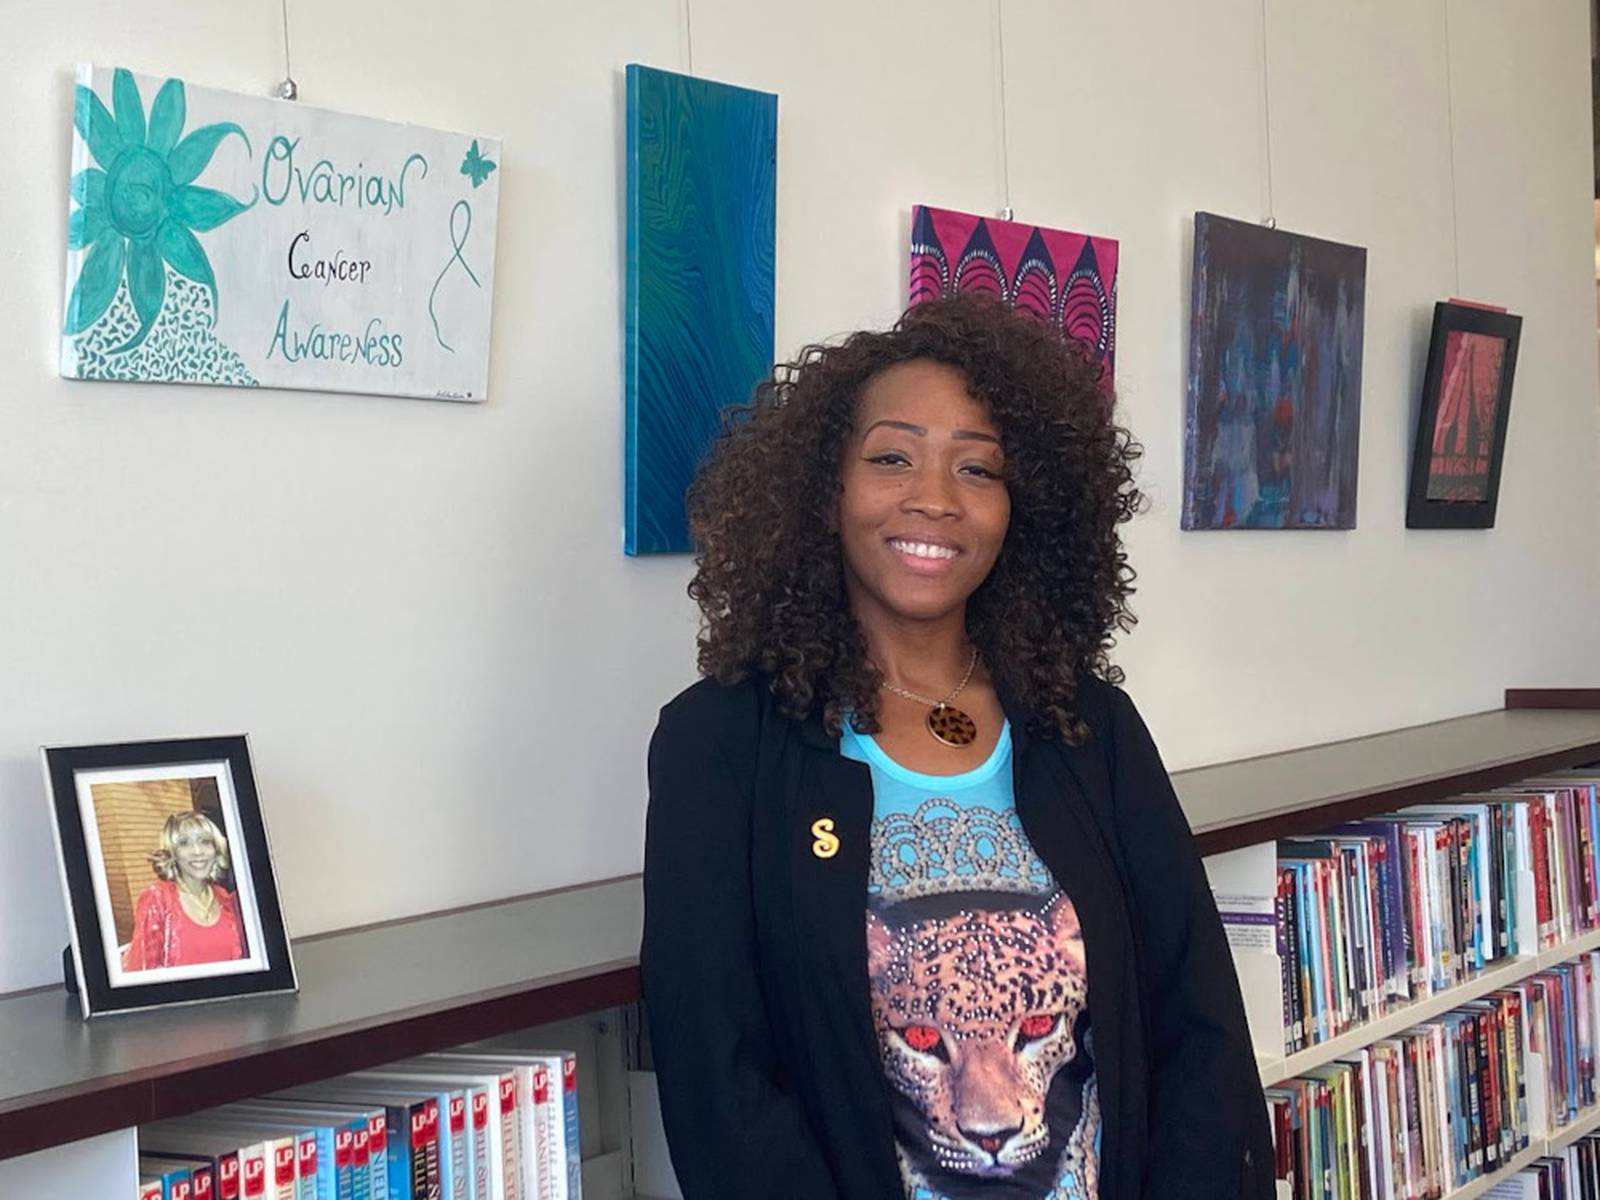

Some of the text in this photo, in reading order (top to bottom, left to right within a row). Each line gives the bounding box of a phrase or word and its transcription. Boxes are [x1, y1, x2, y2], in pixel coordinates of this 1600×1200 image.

[811, 817, 841, 859] S
[564, 1060, 576, 1077] LP
[500, 1082, 513, 1099] LP
[535, 1073, 547, 1091] LP
[451, 1099, 464, 1117] LP
[474, 1095, 486, 1113] LP
[369, 1117, 385, 1136] LP
[412, 1114, 426, 1132] LP
[336, 1131, 352, 1150] LP
[353, 1131, 368, 1150] LP
[276, 1148, 294, 1167] LP
[300, 1141, 316, 1161] LP
[220, 1160, 238, 1180] LP
[245, 1160, 263, 1179] LP
[194, 1175, 211, 1196] LP
